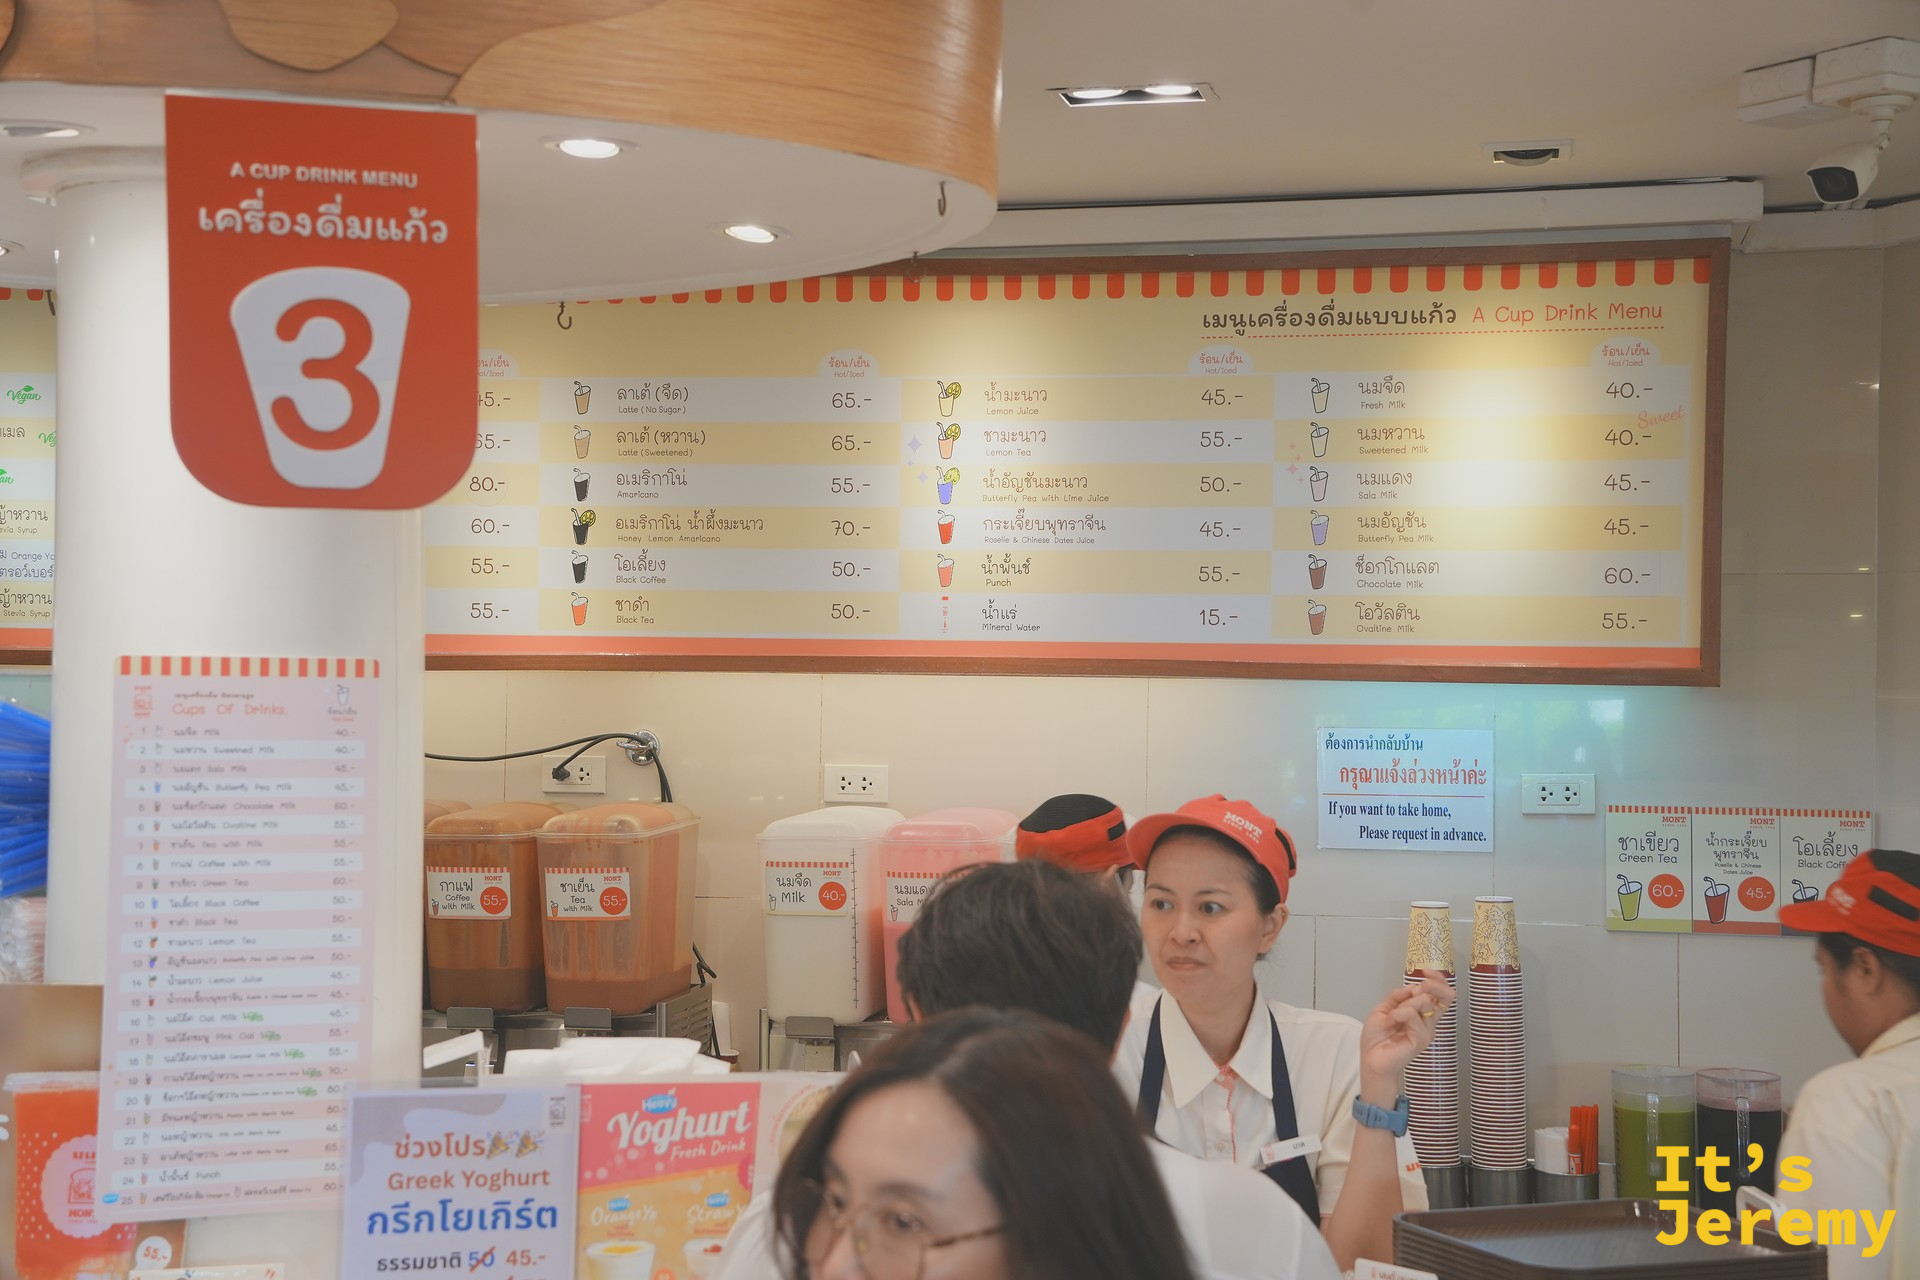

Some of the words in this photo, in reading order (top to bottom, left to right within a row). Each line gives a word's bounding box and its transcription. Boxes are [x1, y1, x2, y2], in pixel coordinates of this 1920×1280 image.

[230, 162, 244, 177] A
[250, 163, 290, 180] CUP
[296, 166, 356, 184] DRINK
[363, 170, 417, 188] MENU
[199, 187, 448, 243] เครื่องดื่มแก้ว
[1203, 299, 1456, 336] เมนูเครื่องดื่มแบบแก้ว
[1473, 307, 1485, 322] A
[1496, 306, 1534, 327] Cup
[1545, 303, 1597, 321] Drink
[1609, 303, 1662, 320] Menu
[1602, 343, 1650, 356] ร้อน/เย็น
[829, 355, 870, 368] ร้อน/เย็น
[1200, 351, 1244, 364] ร้อน/เย็น
[271, 298, 381, 450] 3
[617, 383, 650, 400] ลาเต้
[984, 382, 1047, 401] น้ำมะนาว
[1358, 375, 1405, 394] นมจืด
[1606, 382, 1653, 398] 40.-
[832, 393, 872, 408] 65.-
[1201, 389, 1243, 405] 45.-
[1361, 401, 1383, 409] Fresh
[1389, 400, 1406, 408] Milk
[1016, 407, 1038, 415] Juice
[1637, 405, 1685, 429] Sweet
[617, 426, 650, 443] ลาเต้
[654, 430, 706, 445] (หวาน)
[984, 430, 1046, 442] ชามะนาว
[1201, 432, 1243, 447] 55.-
[1357, 428, 1425, 440] นมหวาน
[1605, 429, 1652, 445] 40.-
[831, 435, 871, 450] 65.-
[1359, 445, 1407, 454] Sweetened
[1412, 445, 1429, 453] Milk
[469, 477, 505, 491] 80.-
[616, 468, 687, 486] อเมริกาโน่
[983, 468, 1087, 493] น้ำอัญชันมะนาว
[1200, 477, 1242, 492] 50.-
[1357, 473, 1413, 485] นมแดง
[1604, 474, 1650, 491] 45.-
[831, 478, 870, 493] 55.-
[983, 494, 1018, 503] Butterfly
[1358, 489, 1376, 499] Sala
[1380, 490, 1398, 498] Milk
[471, 519, 510, 533] 60.-
[615, 514, 681, 530] อเมริกาโน่
[831, 520, 870, 536] 70.-
[1200, 522, 1241, 537] 45.-
[1357, 511, 1426, 533] นมอัญชัน
[1604, 519, 1648, 535] 45.-
[618, 535, 642, 543] Honey
[1358, 535, 1395, 544] Butterfly
[1418, 534, 1434, 542] Milk
[11, 552, 42, 562] Orange
[614, 549, 666, 571] โอเลี้ยง
[1355, 554, 1439, 574] ช็อกโกแลต
[471, 558, 510, 574] 55.-
[832, 562, 871, 576] 50.-
[616, 575, 637, 583] Black
[640, 573, 666, 583] Coffee
[986, 578, 1012, 586] Punch
[1199, 567, 1240, 582] 55.-
[1604, 568, 1650, 584] 60.-
[1357, 579, 1402, 588] Chocolate
[1406, 580, 1424, 588] Milk
[470, 603, 510, 618] 55.-
[616, 596, 649, 611] ชาดำ
[982, 599, 1017, 619] น้ำแร่
[1355, 602, 1421, 620] โอวัลติน
[617, 615, 637, 623] Black
[831, 604, 870, 619] 50.-
[1200, 609, 1238, 625] 15.-
[982, 623, 1012, 631] Mineral
[1356, 624, 1392, 632] Ovaltine
[1397, 624, 1415, 632] Milk
[1602, 613, 1647, 629] 55.-
[1325, 732, 1423, 751] ต้องการนำกลับบ้าน
[1340, 758, 1486, 790] กรุณาแจ้งล่วงหน้าค่ะ
[1329, 802, 1338, 815] If
[1339, 804, 1356, 818] you
[1360, 803, 1383, 815] want
[1386, 804, 1395, 815] to
[1398, 803, 1418, 816] take
[1422, 803, 1451, 819] home,
[1224, 811, 1262, 837] MONT
[1839, 820, 1865, 828] MONT
[1359, 826, 1389, 839] Please
[1392, 829, 1428, 843] request
[1431, 827, 1440, 840] in
[1444, 827, 1486, 841] advance.
[1618, 831, 1679, 852] ชาเขียว
[1792, 832, 1858, 857] โอเลี้ยง
[1619, 853, 1653, 862] Green
[1658, 854, 1677, 863] Tea
[1798, 859, 1822, 868] Black
[440, 878, 473, 891] กาแฟ
[560, 877, 595, 892] ชาเย็น
[776, 872, 812, 887] นมจืด
[782, 891, 805, 902] Milk
[823, 890, 845, 901] 40.-
[1653, 885, 1683, 896] 60.-
[1746, 887, 1771, 898] 45.-
[484, 895, 506, 906] 55.-
[604, 896, 626, 906] 55.-
[607, 1101, 751, 1156] Yoghurt
[395, 1132, 485, 1158] ช่วงโปร
[671, 1144, 706, 1160] Fresh
[711, 1138, 745, 1157] Drink
[388, 1171, 454, 1190] Greek
[461, 1169, 550, 1192] Yoghurt
[368, 1198, 557, 1234] กรีกโยเกิร์ต
[377, 1252, 461, 1271] ธรรมชาติ
[506, 1250, 545, 1265] 45.-
